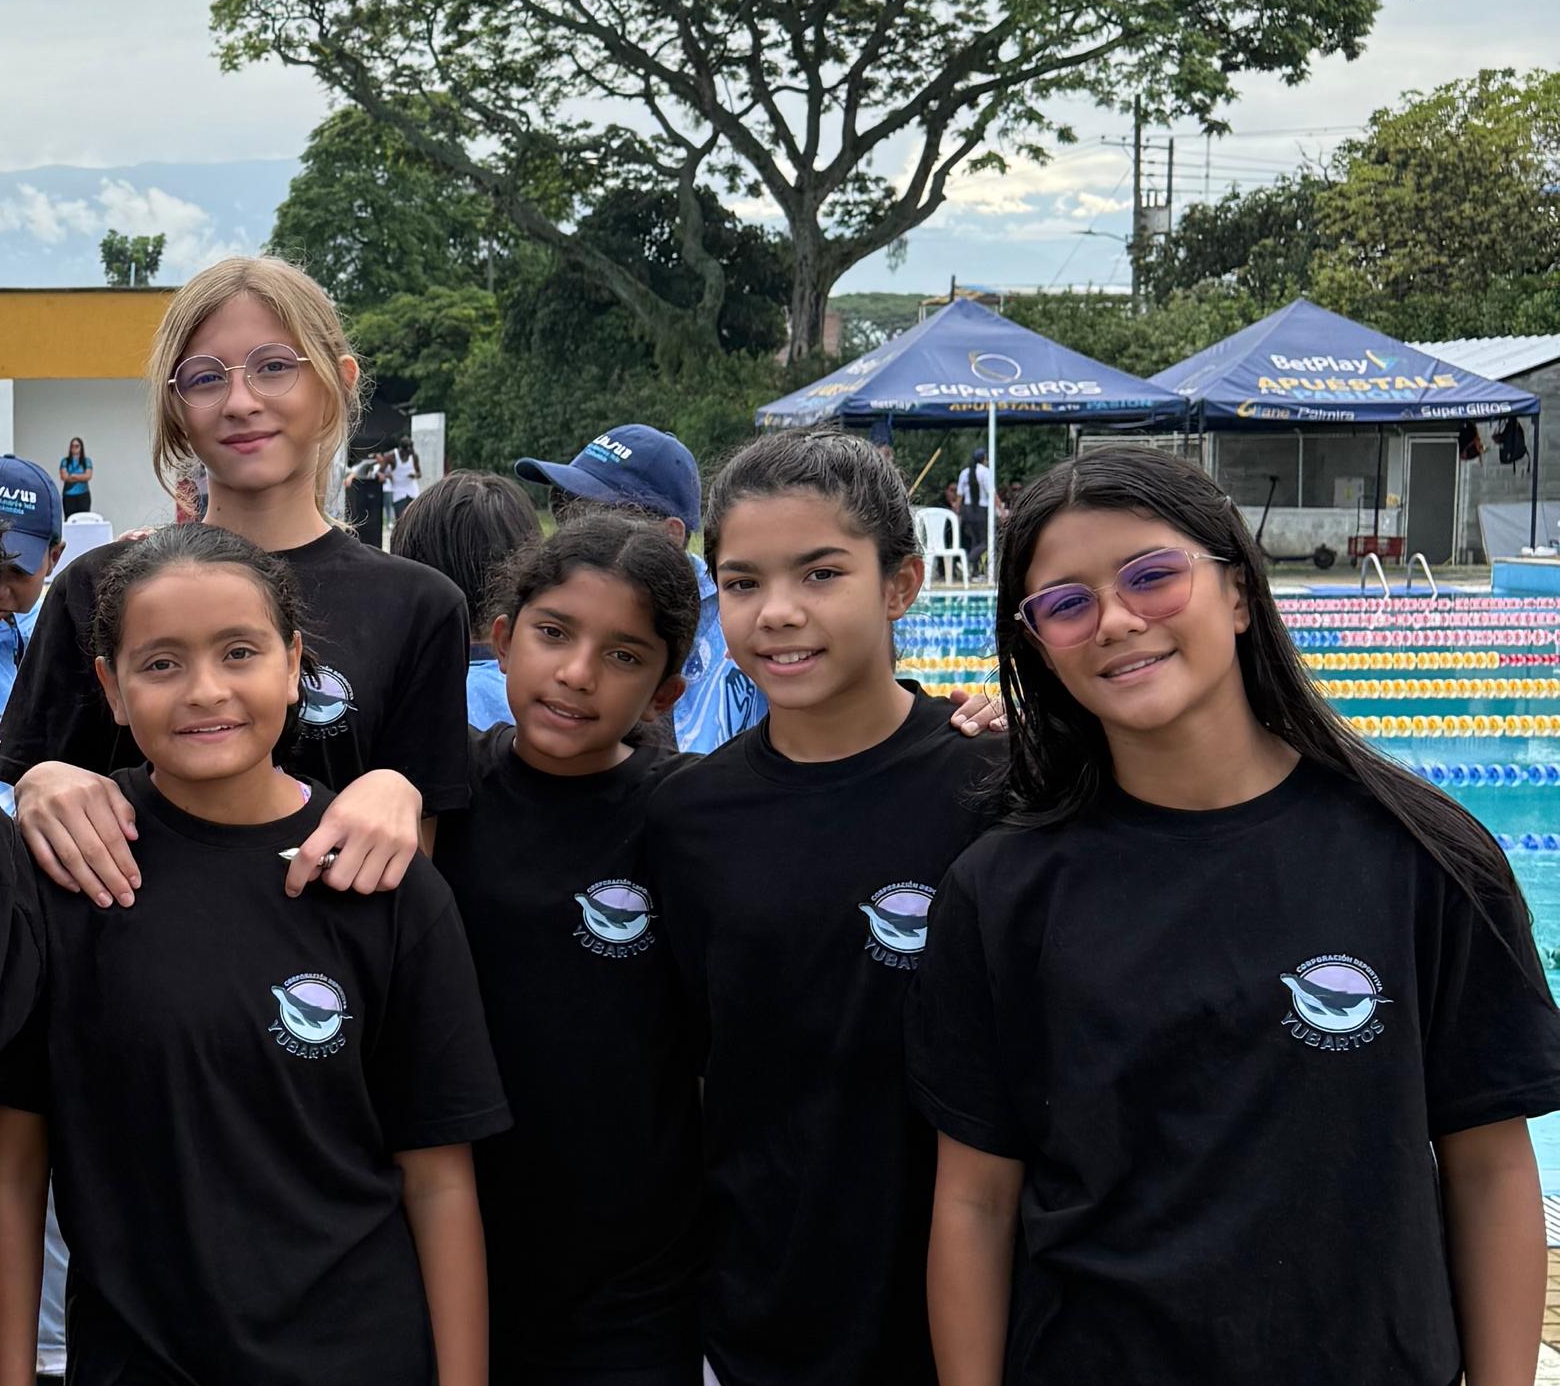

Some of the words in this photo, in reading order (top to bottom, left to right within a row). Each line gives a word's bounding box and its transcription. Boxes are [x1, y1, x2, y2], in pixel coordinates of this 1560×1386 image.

[1270, 354, 1368, 374] BetPlay
[572, 924, 656, 958] YUBARTOS
[1296, 953, 1353, 973] CORPORACIÓN
[1352, 958, 1384, 993] DEPORTIVA
[267, 1019, 347, 1060] YUBARTOS
[1280, 1010, 1386, 1052] YUBARTOS
